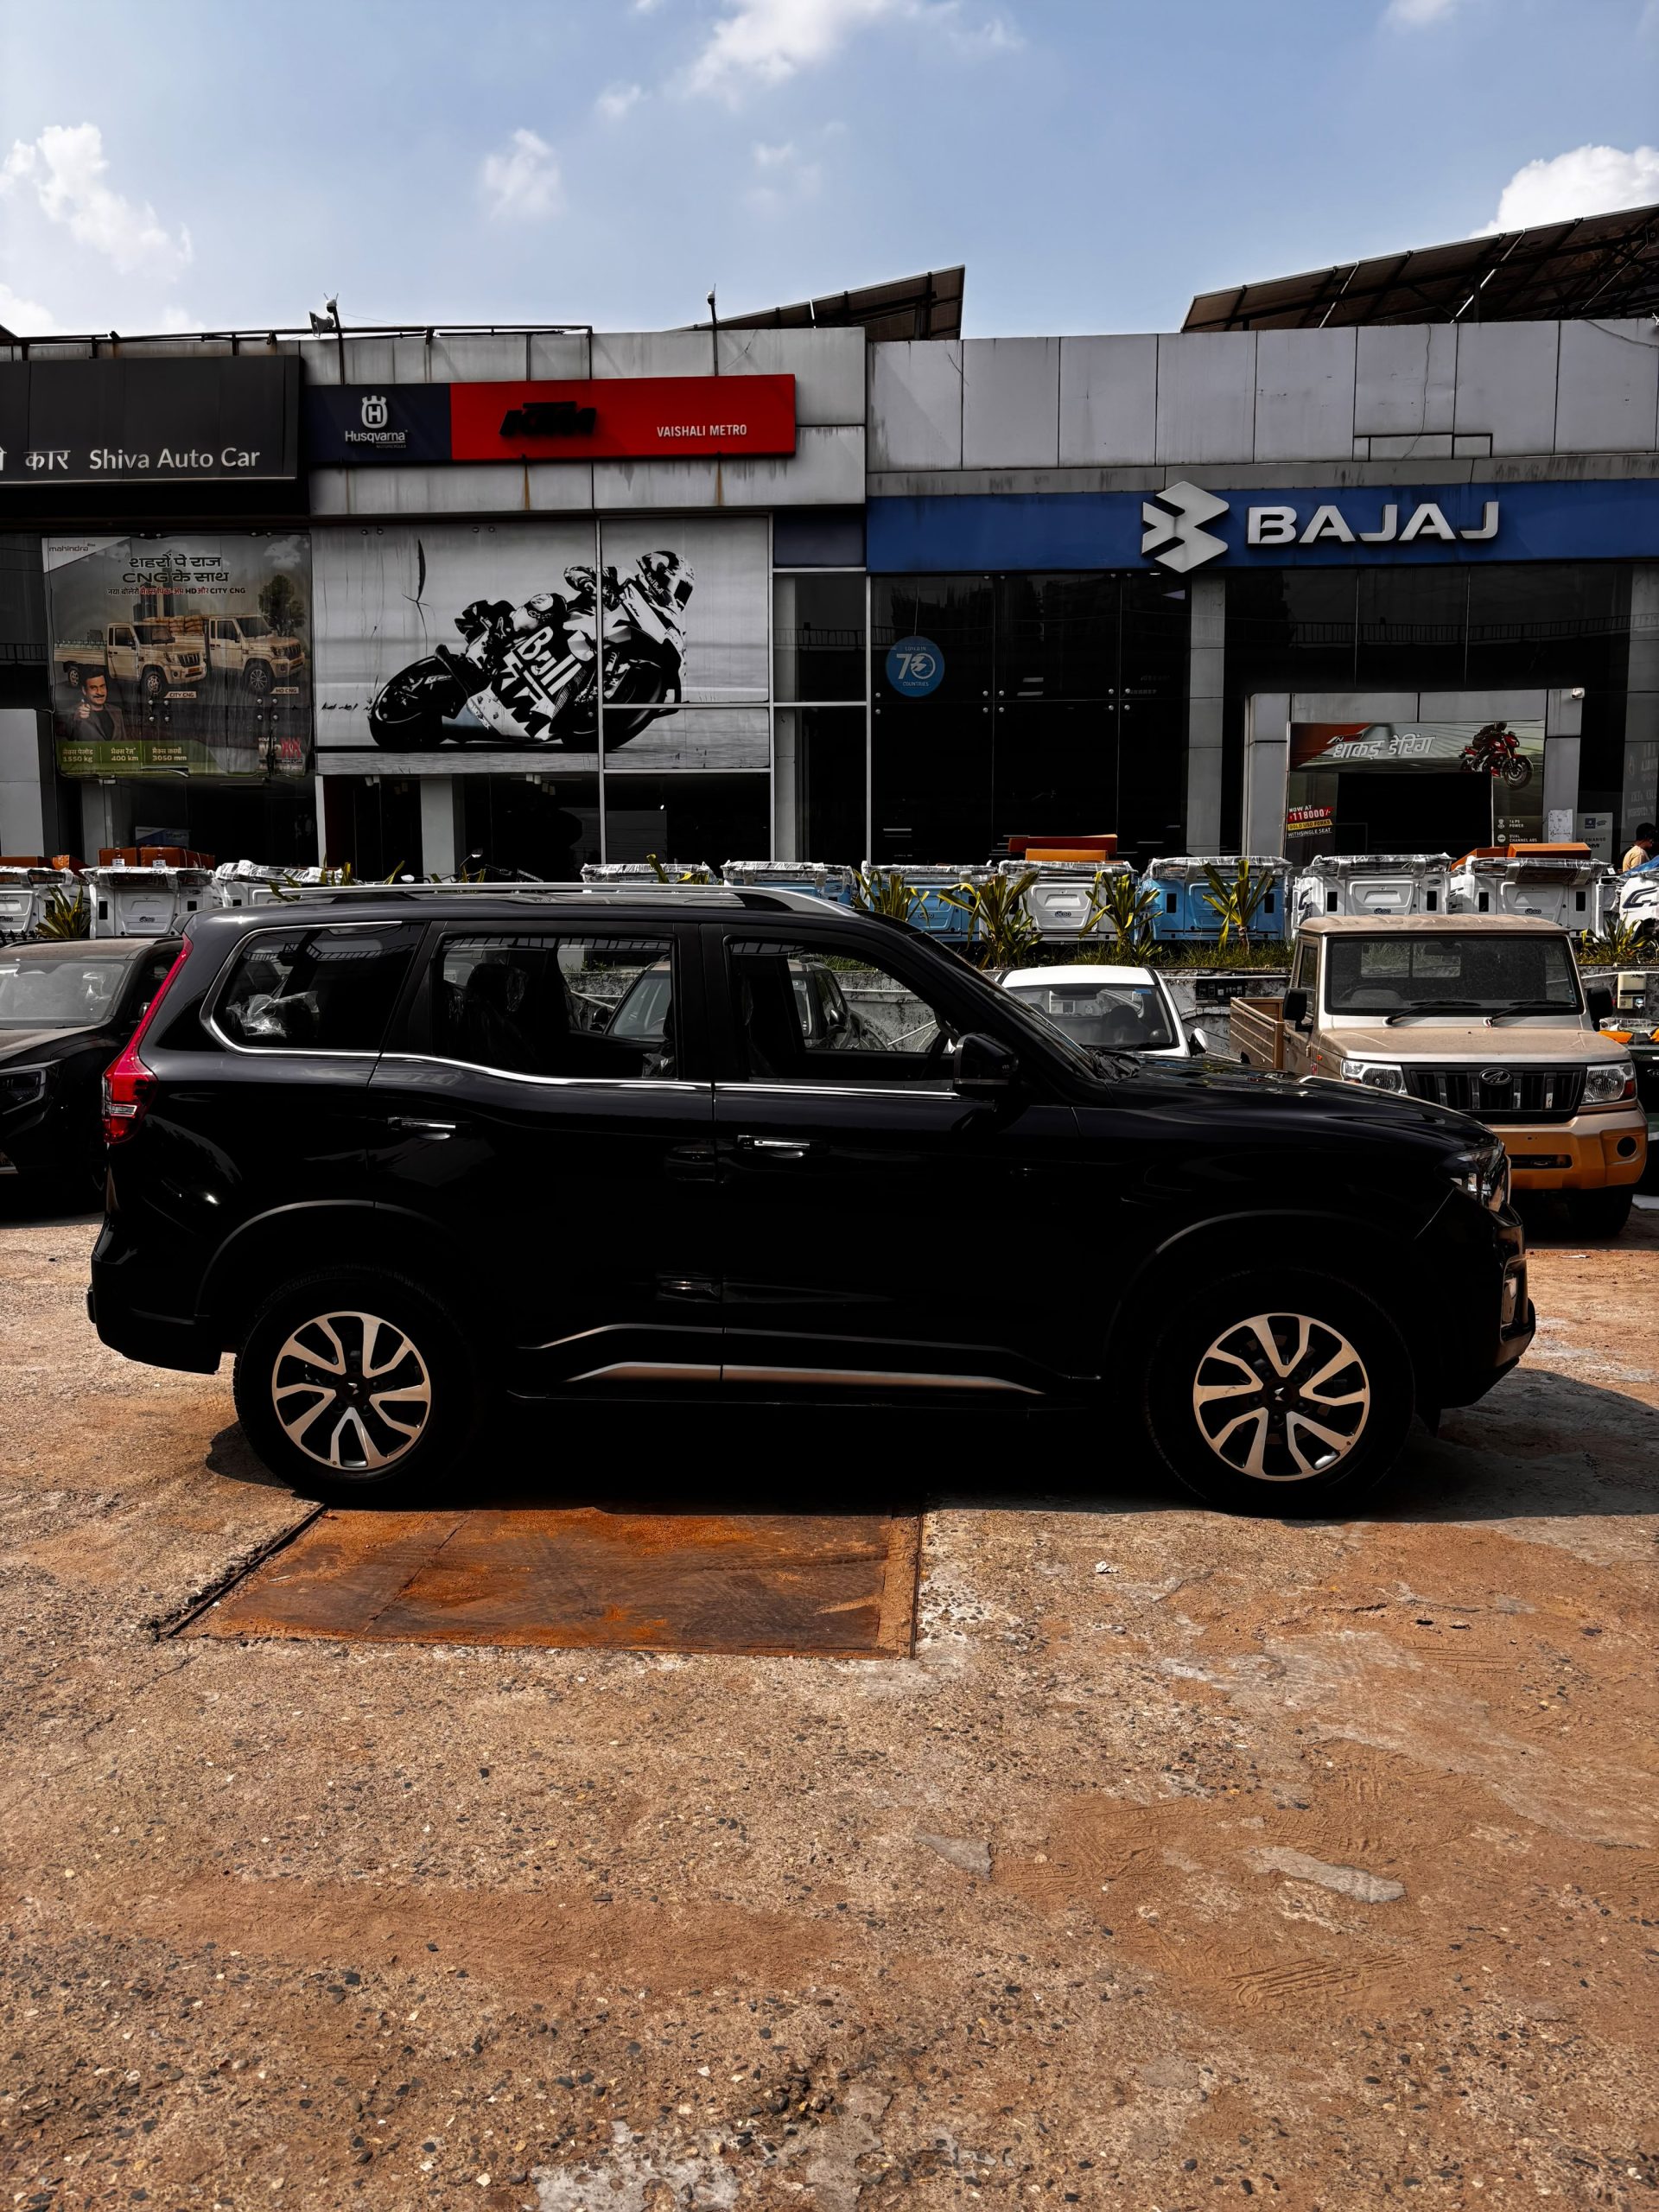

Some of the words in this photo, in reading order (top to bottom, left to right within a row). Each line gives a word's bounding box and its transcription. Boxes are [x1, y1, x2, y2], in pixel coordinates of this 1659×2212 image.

[345, 430, 406, 443] Husqvarna
[657, 425, 706, 438] VAISHALI
[709, 424, 747, 436] METRO
[22, 449, 71, 470] कार
[89, 448, 150, 469] Shiva
[156, 448, 214, 468] Auto
[220, 447, 260, 467] Car
[1247, 501, 1499, 546] BAJAJ
[129, 554, 171, 568] शहरों
[174, 554, 188, 567] पे
[189, 556, 222, 567] राज
[122, 572, 168, 583] CNG
[171, 569, 191, 582] के
[193, 572, 230, 582] साथ
